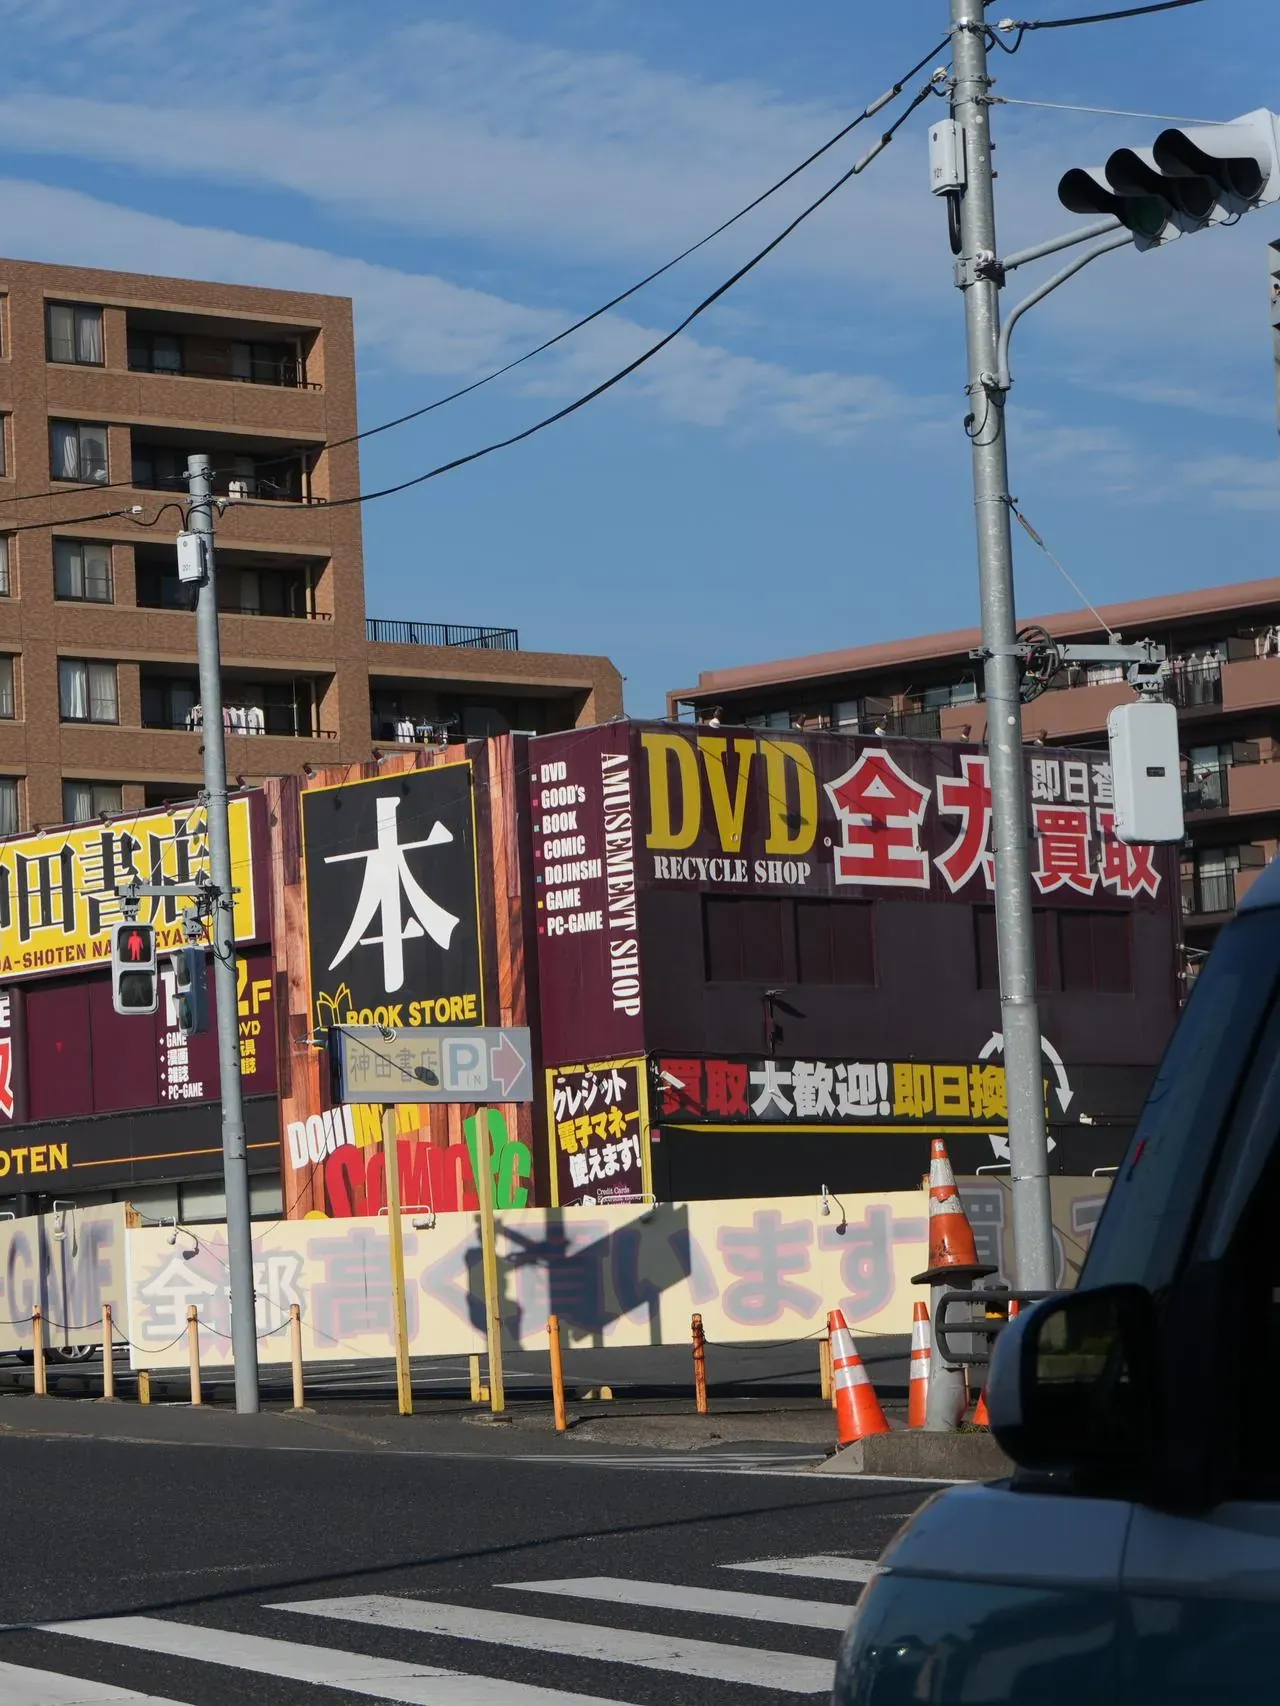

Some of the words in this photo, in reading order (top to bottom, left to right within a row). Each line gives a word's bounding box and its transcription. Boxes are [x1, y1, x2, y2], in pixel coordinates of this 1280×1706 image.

[540, 761, 567, 783] DVD
[1031, 759, 1114, 803] 即日査
[541, 784, 586, 809] GOOD's
[641, 732, 819, 855] DVD
[542, 811, 578, 834] BOOK
[543, 835, 586, 860] COMIC
[601, 752, 637, 932] AMUSEMENT
[545, 858, 602, 885] DOJINSHI
[654, 855, 749, 882] RECYCLE
[754, 859, 812, 885] SHOP
[323, 796, 460, 993] 本
[546, 887, 581, 911] GAME
[547, 910, 603, 936] PC-GAME
[610, 938, 641, 1017] SHOP
[347, 1004, 403, 1028] BOOK
[408, 993, 478, 1028] STORE
[166, 1031, 188, 1048] GAME
[168, 1081, 203, 1100] PC-GAME
[553, 1068, 628, 1121] クレジット
[557, 1105, 640, 1154] 電子マネー
